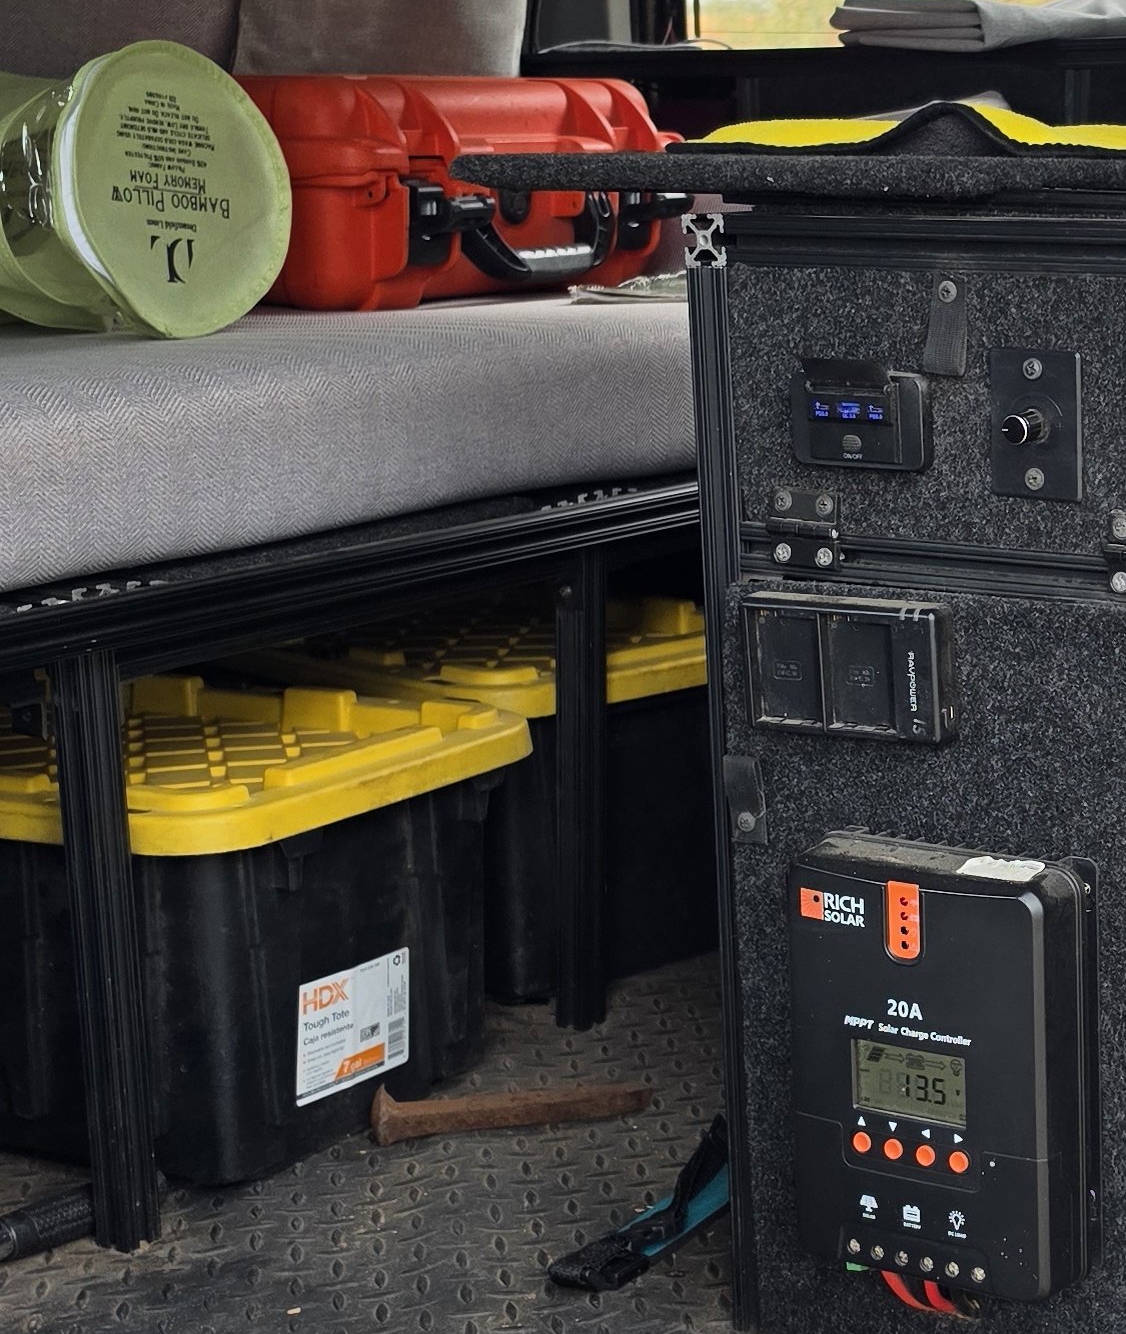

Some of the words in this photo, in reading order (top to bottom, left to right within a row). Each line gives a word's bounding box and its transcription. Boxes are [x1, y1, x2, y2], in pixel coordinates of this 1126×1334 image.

[130, 169, 158, 189] FOAM
[164, 174, 206, 194] MEMORY
[112, 186, 164, 212] PILLOW
[171, 193, 230, 219] BAMBOO
[907, 650, 918, 712] RAVPOWER
[823, 892, 865, 915] RICH
[824, 910, 866, 928] SOLAR
[302, 977, 349, 1016] HDX
[303, 1016, 330, 1032] Tough
[332, 1009, 350, 1022] Tote
[887, 998, 923, 1021] 20A
[303, 1033, 319, 1046] Caja
[321, 1022, 355, 1040] resistente
[844, 1015, 874, 1029] MPPT
[878, 1022, 899, 1035] Solar
[900, 1026, 929, 1041] Charge
[930, 1032, 971, 1047] Controller
[343, 1059, 350, 1072] 7
[906, 1074, 946, 1105] 13.5
